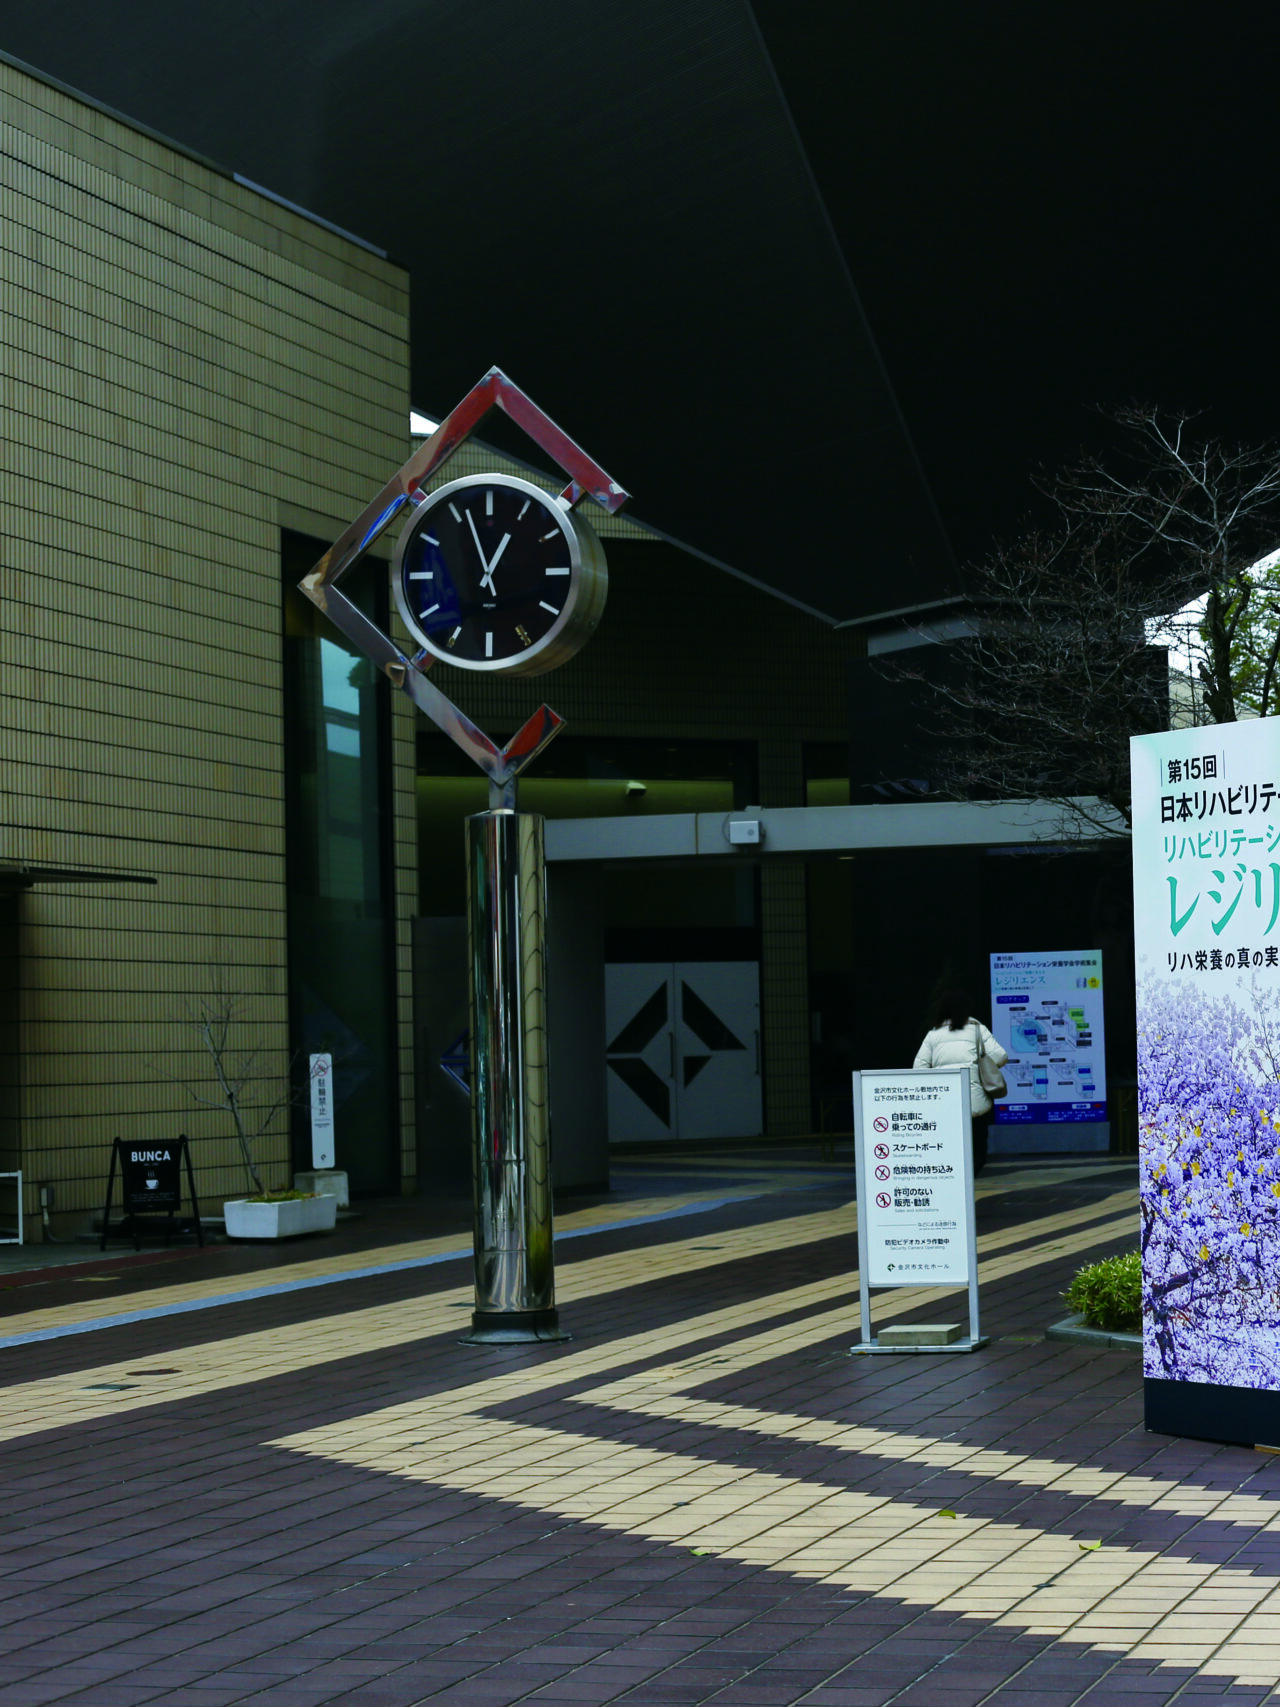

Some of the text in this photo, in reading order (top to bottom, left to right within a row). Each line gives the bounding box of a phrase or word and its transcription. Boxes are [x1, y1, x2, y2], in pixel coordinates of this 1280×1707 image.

[1167, 754, 1218, 784] 第15回
[891, 1112, 923, 1122] 自転車に
[891, 1122, 937, 1131] 乗っての通行
[892, 1142, 944, 1152] スケートボード
[131, 1150, 171, 1162] BUNCA
[893, 1165, 954, 1175] 危険物の持ち込み
[894, 1187, 933, 1197] 許可のない
